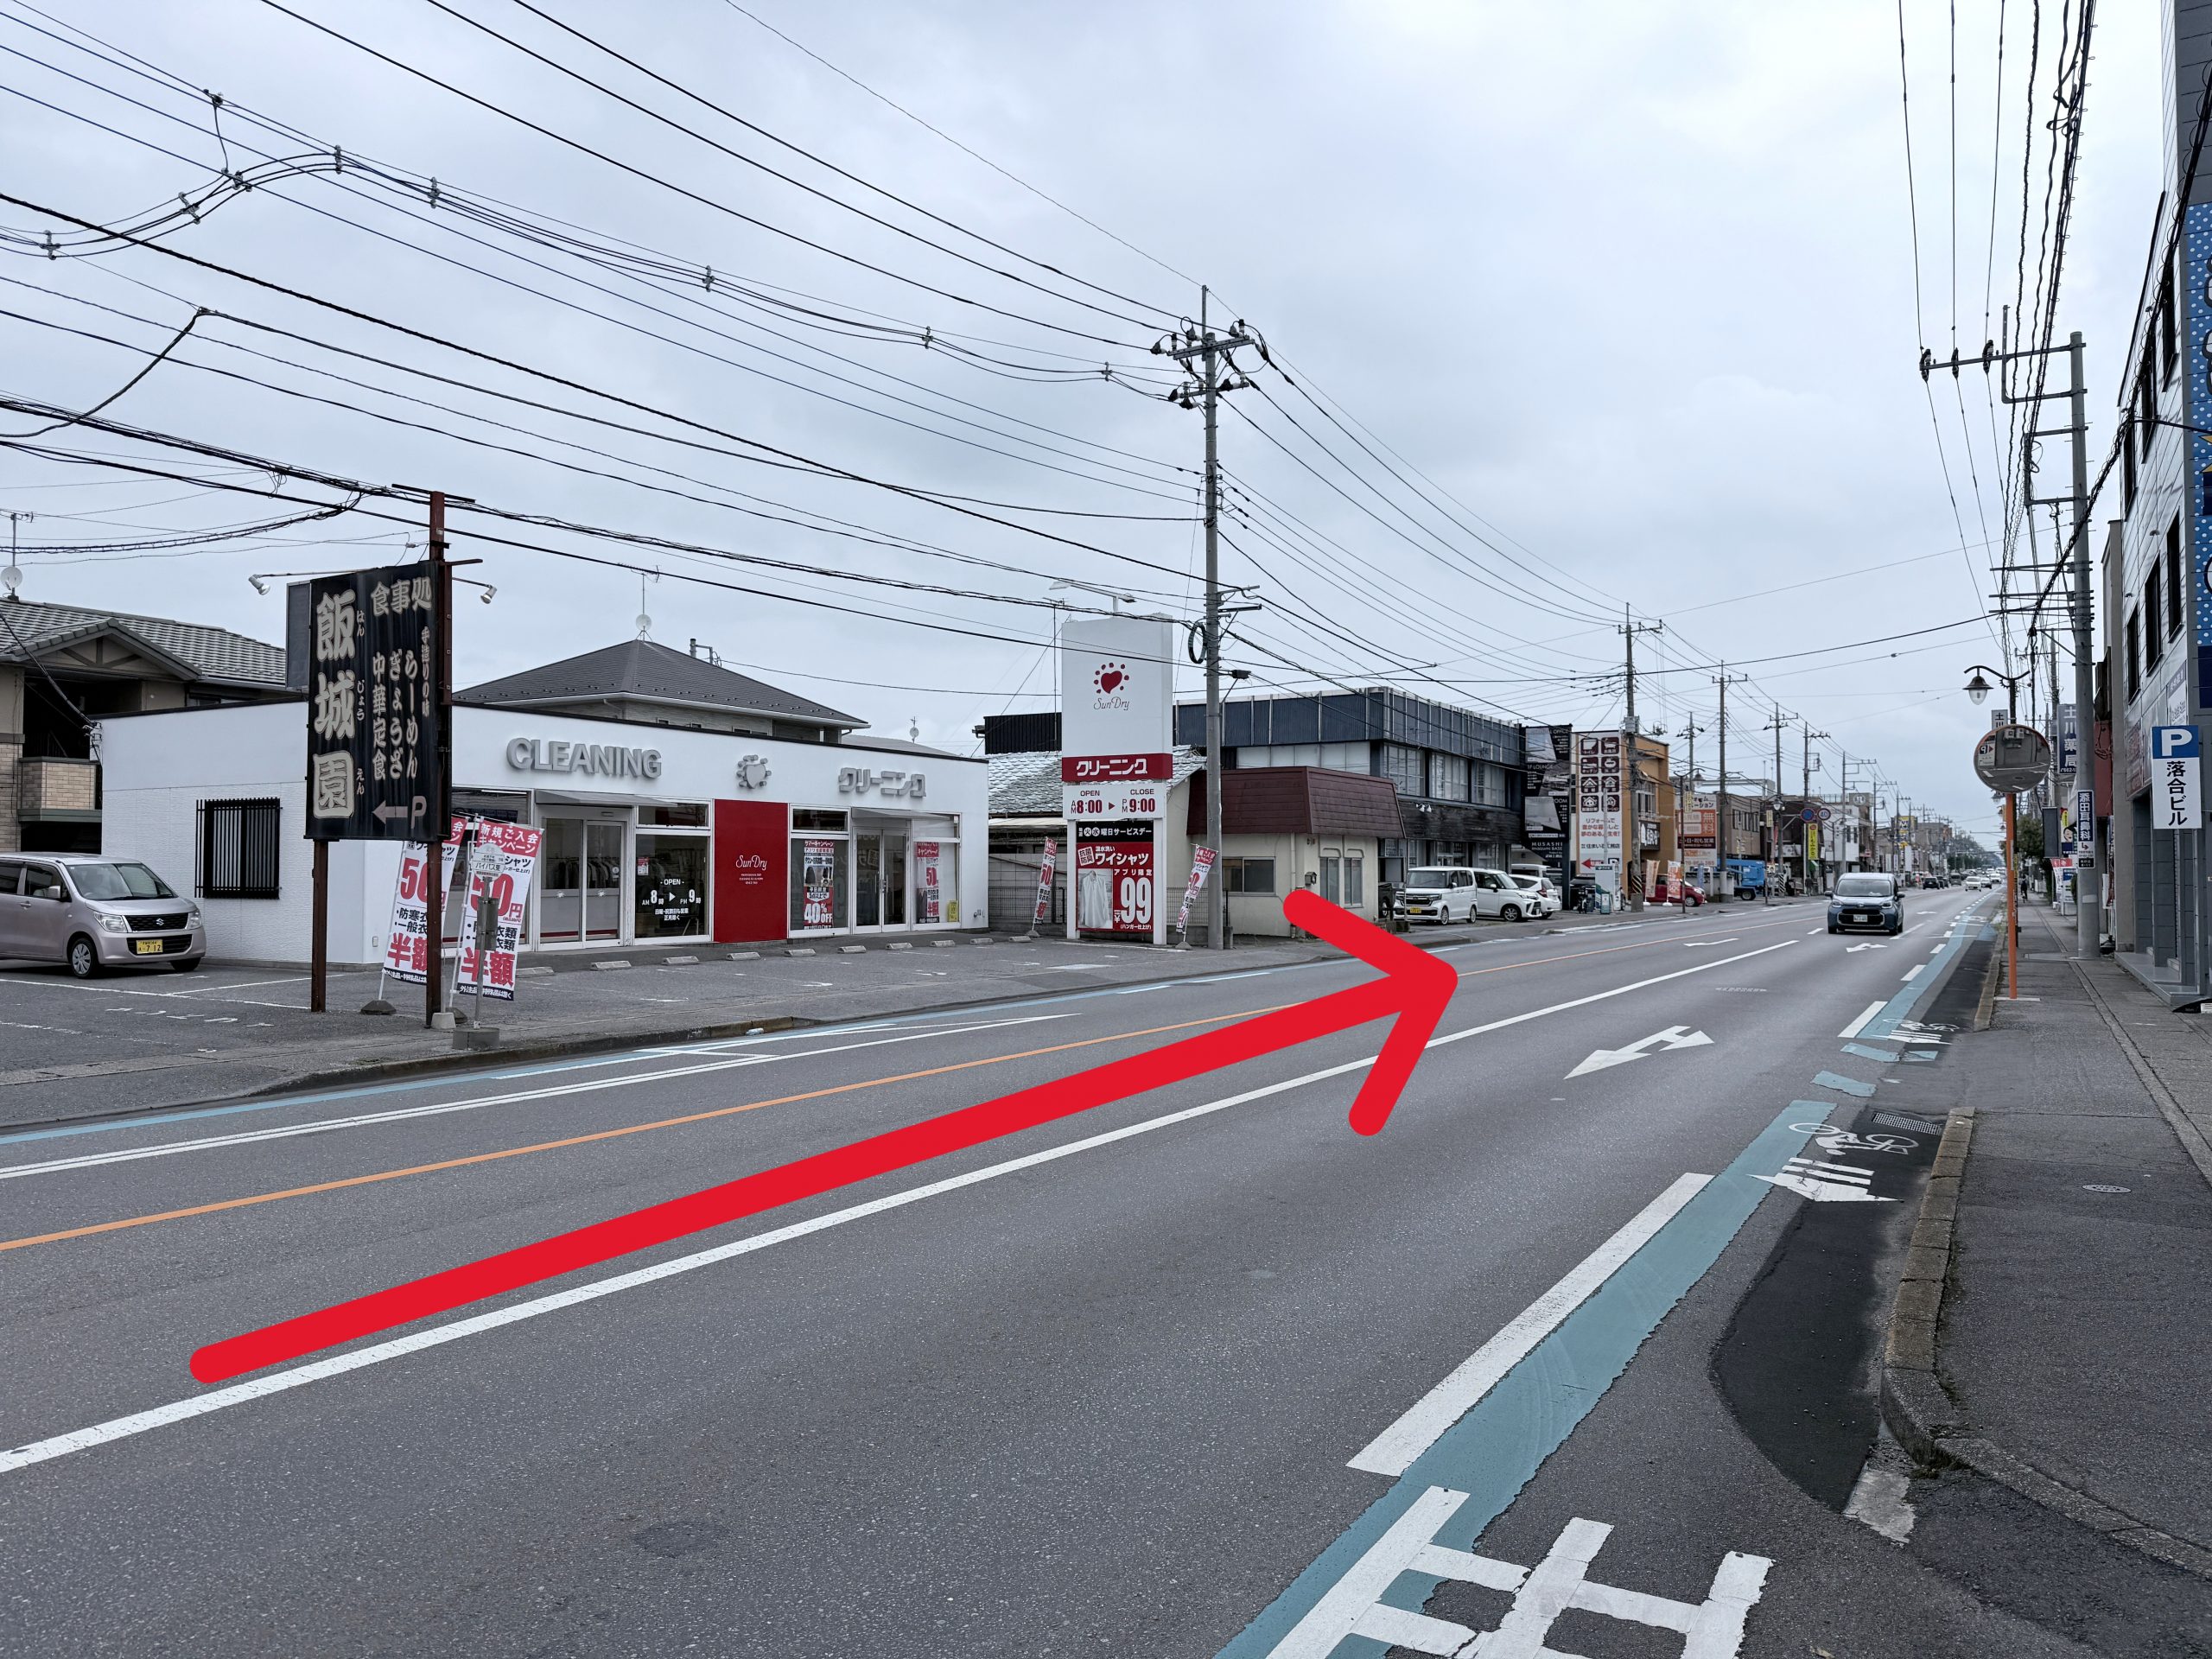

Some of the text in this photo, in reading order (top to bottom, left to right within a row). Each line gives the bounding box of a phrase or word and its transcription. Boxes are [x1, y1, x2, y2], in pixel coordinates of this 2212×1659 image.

[371, 576, 432, 616] 食事処
[313, 588, 356, 819] 飯城園
[356, 610, 365, 795] はん じょう えん
[372, 652, 387, 781] 中華定食
[389, 649, 404, 780] ぎょうざ
[404, 649, 419, 779] らーめん
[506, 738, 662, 779] CLEANING
[2161, 728, 2193, 757] P
[410, 795, 427, 830] P
[1077, 799, 1103, 814] 8:00
[1129, 798, 1155, 813] 9:00
[2166, 760, 2188, 826] 落合ビル
[480, 823, 539, 844] 新規ご入会
[1096, 852, 1149, 865] ワイシャツ
[821, 913, 833, 924] OFF
[1121, 877, 1152, 924] 99
